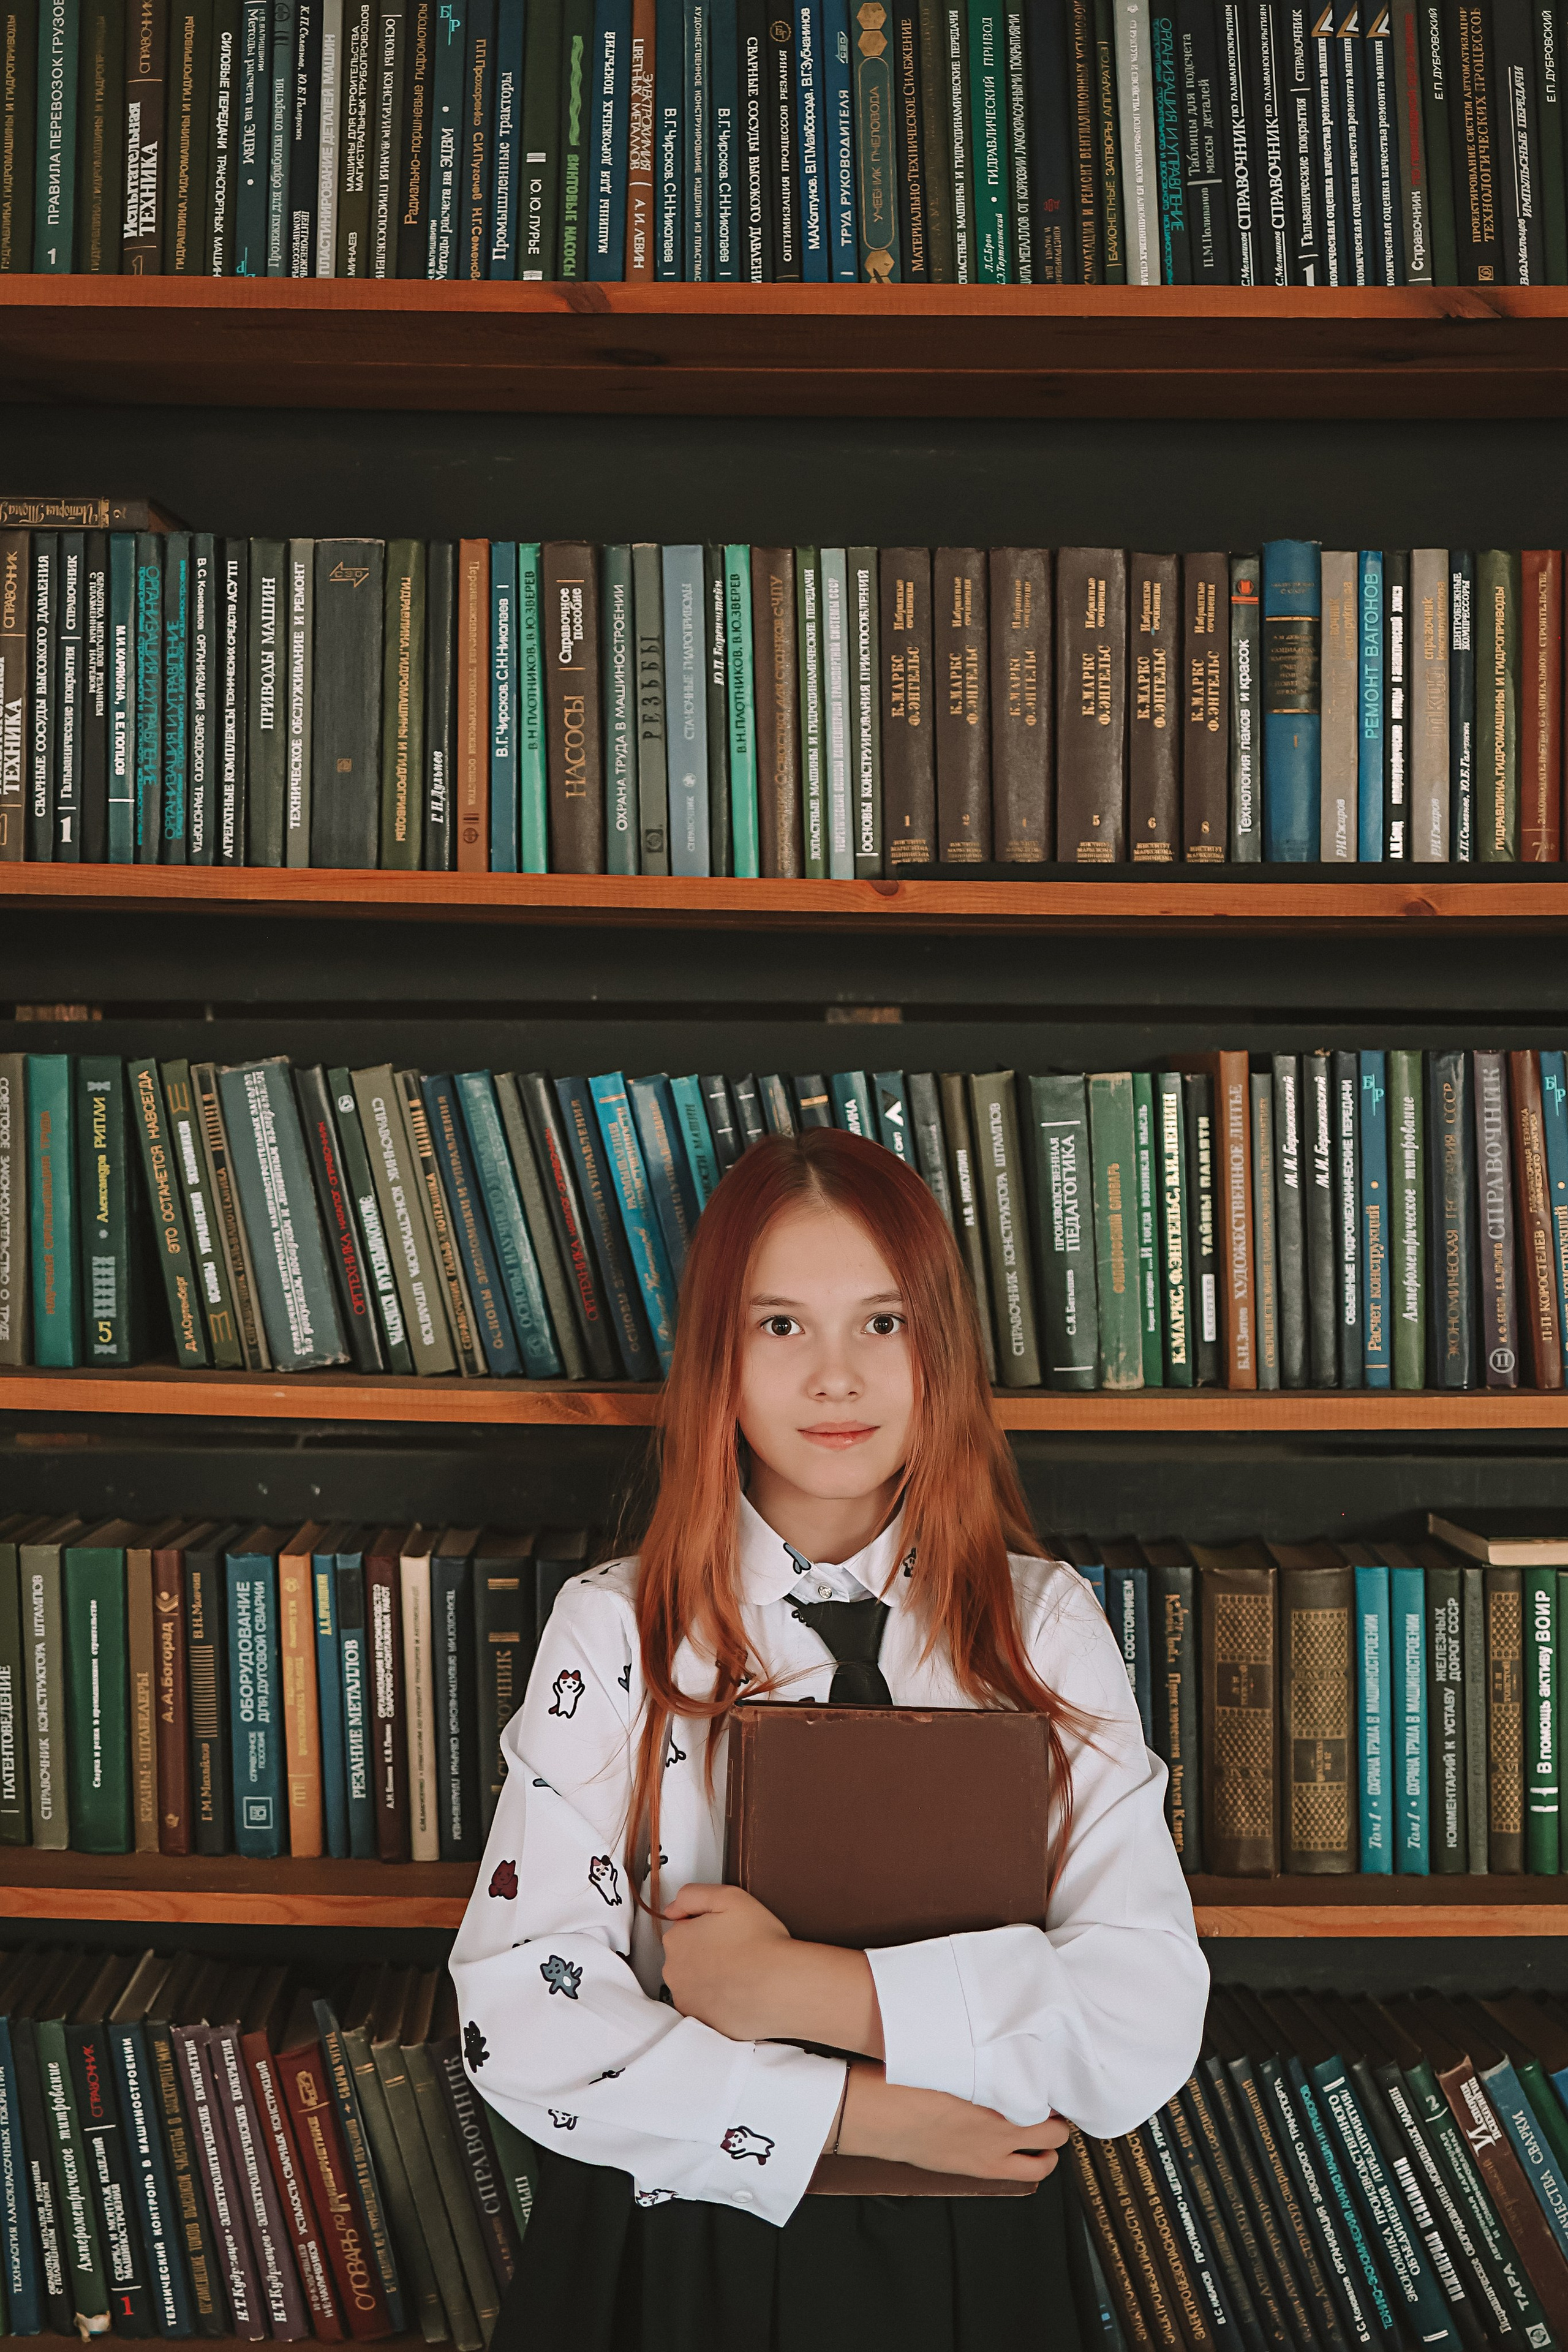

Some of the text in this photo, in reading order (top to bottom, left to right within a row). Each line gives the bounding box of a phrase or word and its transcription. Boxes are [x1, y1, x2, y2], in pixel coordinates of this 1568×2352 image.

[50, 58, 64, 149] ПЕРЕВОЗОК
[355, 5, 369, 191] МАГИСТРАЛЬНЫХ ТРУБОПРОВОДОВ
[982, 17, 998, 184] ГИДРАВЛИЧЕСКИЙ ПРИВОД
[1182, 34, 1200, 175] Таблицы для подсчета
[1293, 9, 1304, 81] СПРАВОЧНИК
[124, 102, 140, 238] Испытательная
[346, 26, 359, 191] МАШИНЫ ДЛЯ СТРОИТЕЛЬСТВА
[404, 3, 428, 225] Радиально-поршневые гидромоторы
[493, 72, 514, 260] Промышленные тракторы
[598, 31, 616, 254] МАШИНЫ ДЛЯ ДОРОЖНЫХ ПОКРЫТИЙ
[779, 50, 792, 262] ОПТИМИЗАЦИЯ ПРОЦЕССОВ РЕЗАНИЯ
[839, 90, 852, 246] ТРУД РУКОВОДИТЕЛЯ
[870, 86, 883, 222] УЧЕБНИК ПЧЕЛОВОДА
[1101, 46, 1118, 260] БАЙОНЕТНЫЕ ЗАТВОРЫ АППАРАТОВ
[1199, 79, 1215, 173] массы деталей
[1225, 5, 1251, 229] СПРАВОЧНИК ПО ГАЛЬВАНОПОКРЫТИЯМ
[1460, 7, 1480, 243] ПРОЕКТИРОВАНИЕ СИСТЕМ АВТОМАТИЗАЦИИ
[1471, 7, 1494, 241] ТЕХНОЛОГИЧЕСКИХ ПРОЦЕССОВ
[48, 153, 61, 225] ПРАВИЛА
[140, 141, 157, 236] ТЕХНИКА
[268, 78, 285, 267] Протяжки для обработки отверстий
[1297, 98, 1313, 246] Гальванические покрытия
[1411, 191, 1425, 271] Справочник
[48, 248, 56, 264] 1
[261, 577, 276, 729] ПРИВОДЫ МАШИН
[559, 588, 572, 663] Справочное
[571, 588, 584, 640] пособие
[612, 584, 625, 718] МАШИНОСТРОЕНИИ
[804, 570, 816, 619] ПЕРЕДАЧИ
[1085, 578, 1097, 628] Избранные
[1098, 579, 1106, 627] сочинения
[1364, 573, 1379, 739] РЕМОНТ ВАГОНОВ
[1453, 572, 1462, 650] ЦЕНТРОБЕЖНЫЕ
[1461, 580, 1471, 650] КОМПРЕССОРЫ
[35, 556, 49, 817] СВАРНЫЕ СОСУДЫ ВЫСОКОГО ДАВЛЕНИЯ
[289, 562, 305, 829] ТЕХНИЧЕСКОЕ ОБСЛУЖИВАНИЕ И РЕМОНТ
[641, 635, 662, 739] РЕЗЬБЫ
[805, 622, 818, 734] ГИДРОДИНАМИЧЕСКИЕ
[857, 570, 873, 851] ОСНОВЫ КОНСТРУИРОВАНИЯ ПРИСПОСОБЛЕНИЙ
[1238, 639, 1253, 689] красок
[564, 695, 586, 797] НАСОСЫ
[615, 735, 627, 774] ТРУДА
[808, 748, 820, 796] МАШИНЫ
[1239, 709, 1251, 750] лаков
[615, 778, 628, 831] ОХРАНА
[810, 799, 821, 859] ЛОПАСТНЫЕ
[1093, 814, 1100, 826] 5
[1148, 817, 1156, 829] 6
[1238, 755, 1253, 835] Технология
[94, 1098, 109, 1222] Александра РИПЛИ
[137, 1070, 181, 1253] ЭТО ОСТАНЕТСЯ НАВСЕГДА
[1050, 1137, 1064, 1251] ПРОИЗВОДСТВЕННАЯ
[1063, 1134, 1080, 1251] ПЕДАГОГИКА
[1108, 1163, 1121, 1210] СЛОВАРЬ
[1198, 1117, 1213, 1256] ТАЙНЫ ПАМЯТИ
[1229, 1084, 1248, 1300] ХУДОЖЕСТВЕННОЕ ЛИТЬЕ
[1401, 1096, 1420, 1322] Амперометрическое титрование
[1482, 1067, 1507, 1240] СПРАВОЧНИК
[989, 1102, 1024, 1356] СПРАВОЧНИК КОНСТРУКТОРА ШТАМПОВ
[1365, 1205, 1384, 1351] Расчет конструкций
[99, 1321, 111, 1342] 5
[1447, 1229, 1460, 1360] ЭКОНОМИЧЕСКАЯ
[237, 1581, 254, 1722] ОБОРУДОВАНИЕ
[254, 1581, 270, 1722] ДЛЯ ДУГОВОЙ СВАРКИ
[1435, 1608, 1446, 1681] ЖЕЛЕЗНЫХ
[1447, 1597, 1461, 1681] ДОРОГ СССР
[1536, 1591, 1553, 1774] В помощь активу ВОИР
[0, 1665, 16, 1800] ПАТЕНТОВЕДЕНИЕ
[344, 1639, 366, 1798] РЕЗАНИЕ МЕТАЛЛОВ
[1444, 1687, 1456, 1735] УСТАВУ
[1444, 1754, 1457, 1847] КОММЕНТАРИЙ
[83, 2045, 103, 2117] СПРАВОЧНИК
[122, 2038, 149, 2153] МАШИНОСТРОЕНИИ
[221, 2039, 268, 2226] ЭЛЕКТРОЛИТИЧЕСКИЕ ПОКРЫТИЯ
[444, 2055, 501, 2214] СПРАВОЧНИК
[1512, 2110, 1544, 2165] СВАРКИ
[144, 2175, 162, 2235] КОНТРОЛЬ
[1274, 2078, 1346, 2274] ОРГАНИЗАЦИЯ ЗАВОДСКОГО ТРАНСПОРТА
[1329, 2095, 1387, 2224] ПРОИЗВОДСТВЕННОГО
[155, 2242, 176, 2326] ТЕХНИЧЕСКИЙ
[344, 2230, 375, 2310] СЛОВАРЬ
[1393, 2157, 1465, 2301] ИНЖЕНЕРНАЯ ПСИХОЛОГИЯ
[1503, 2263, 1529, 2310] ТАРА
